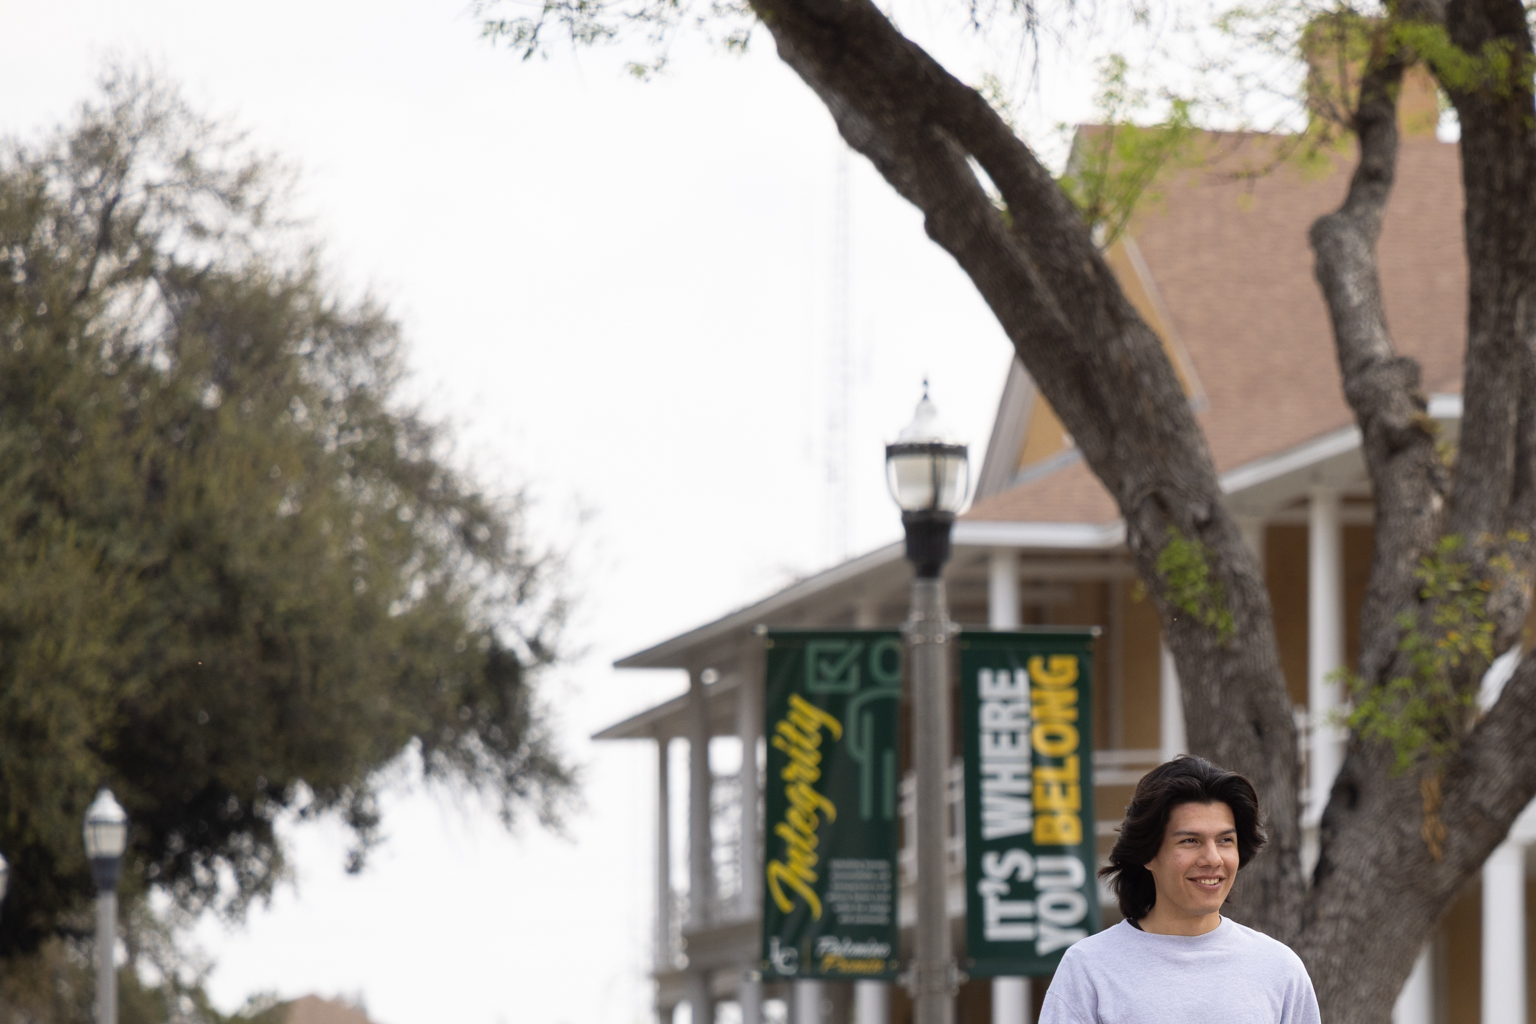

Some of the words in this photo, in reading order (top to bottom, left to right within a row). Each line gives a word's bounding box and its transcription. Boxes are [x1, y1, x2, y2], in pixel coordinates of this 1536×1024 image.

[766, 693, 843, 922] Integrity
[978, 667, 1033, 841] WHERE
[1027, 654, 1083, 847] BELONG
[1034, 855, 1089, 957] YOU
